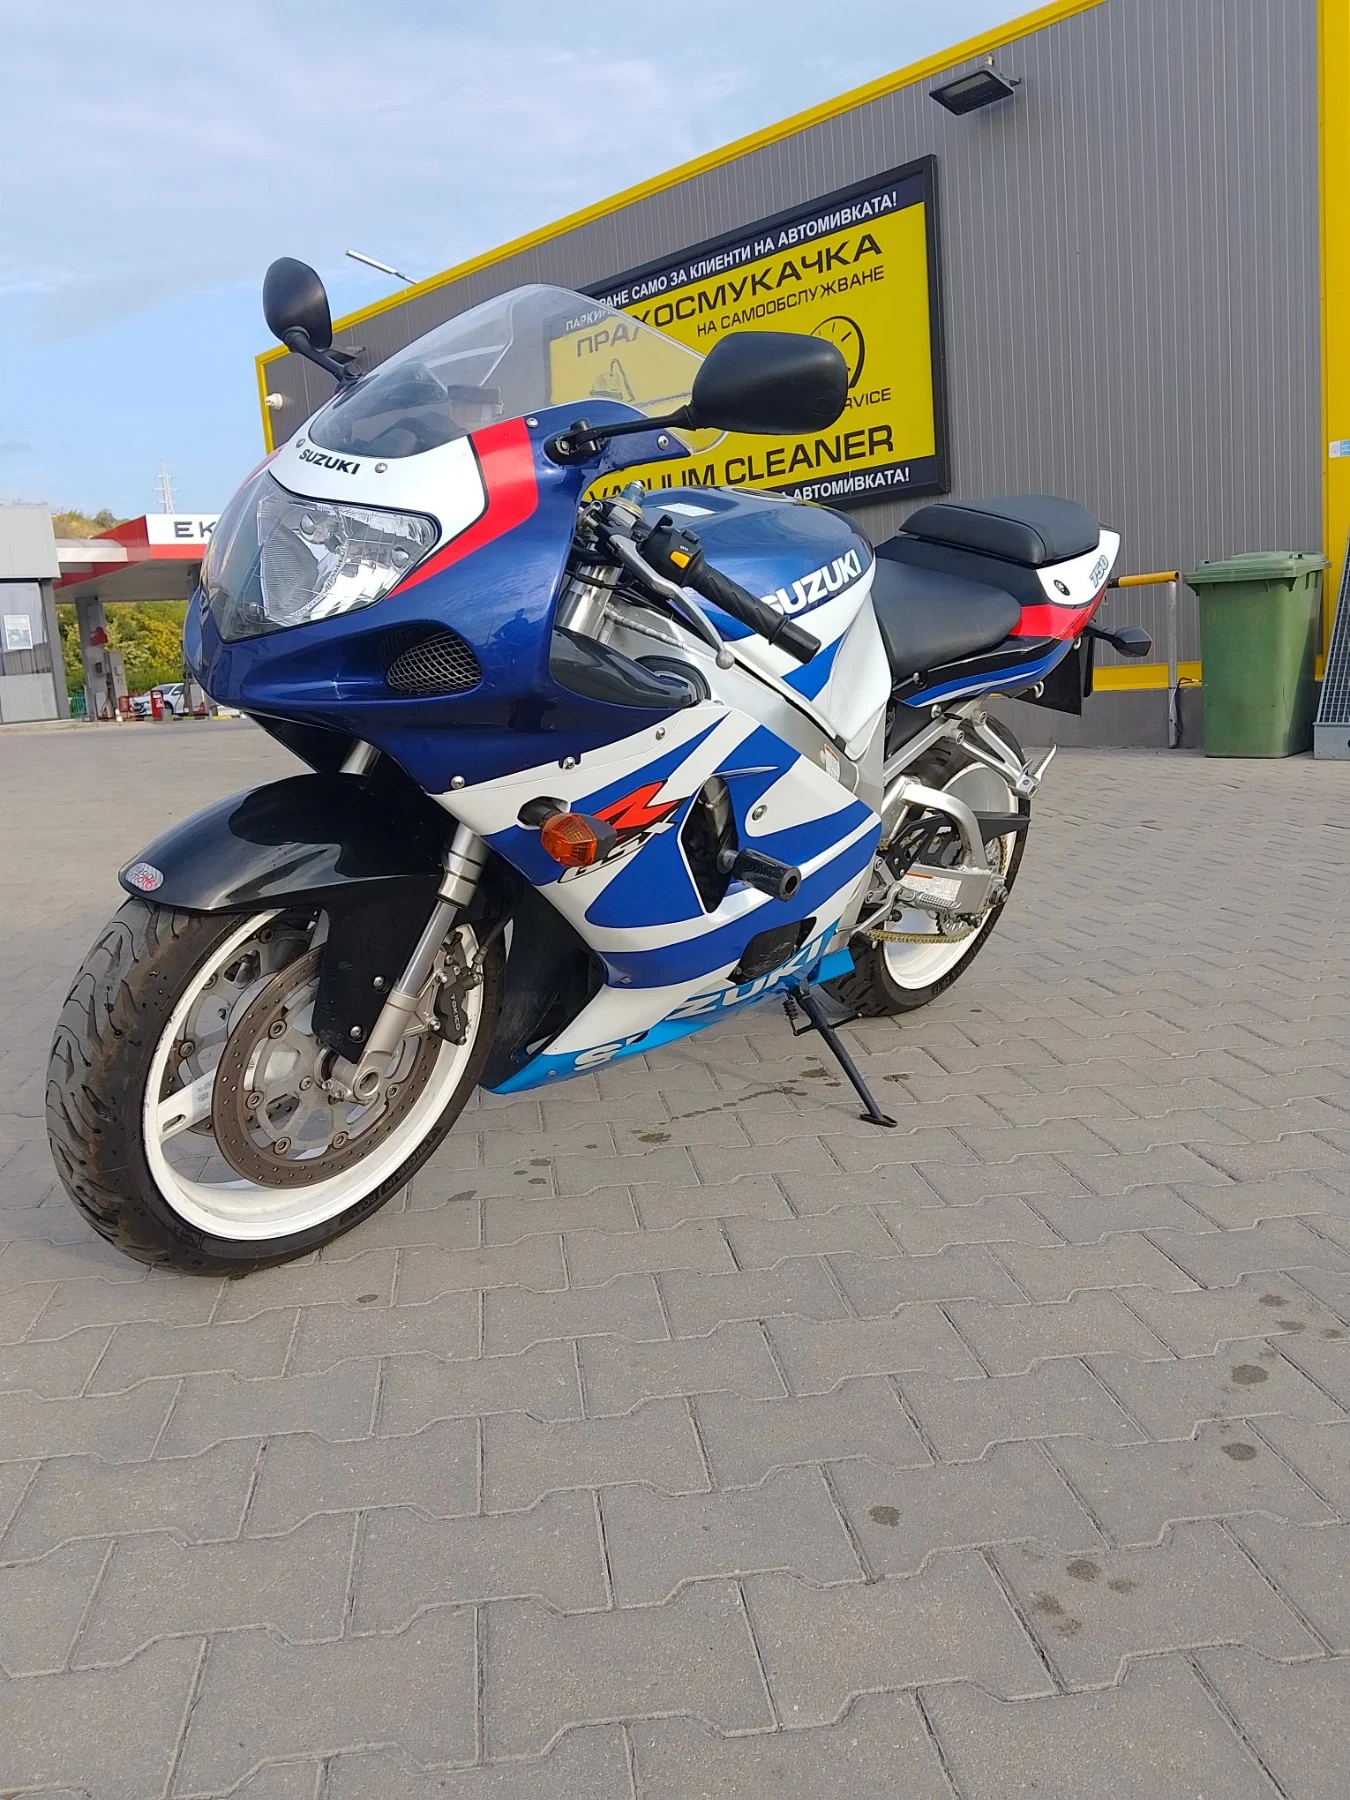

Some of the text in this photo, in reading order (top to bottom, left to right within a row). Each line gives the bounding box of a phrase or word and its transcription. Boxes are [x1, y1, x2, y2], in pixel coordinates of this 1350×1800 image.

[631, 276, 667, 300] САМО
[670, 269, 688, 286] ЗА
[690, 244, 751, 280] КЛИЕНТИ
[754, 237, 775, 256] НА
[778, 191, 898, 248] АВТОМИВКАТА!
[697, 265, 885, 337] НА САМООБСЛУЖВАНЕ
[299, 449, 361, 475] SUZUKI
[725, 425, 894, 485] CLEANER
[793, 466, 910, 501] АВТОМИВКАТА!
[173, 521, 217, 538] EK
[1089, 555, 1109, 589] 750
[450, 993, 461, 1031] TOKICO
[574, 936, 823, 1071] SZUKI
